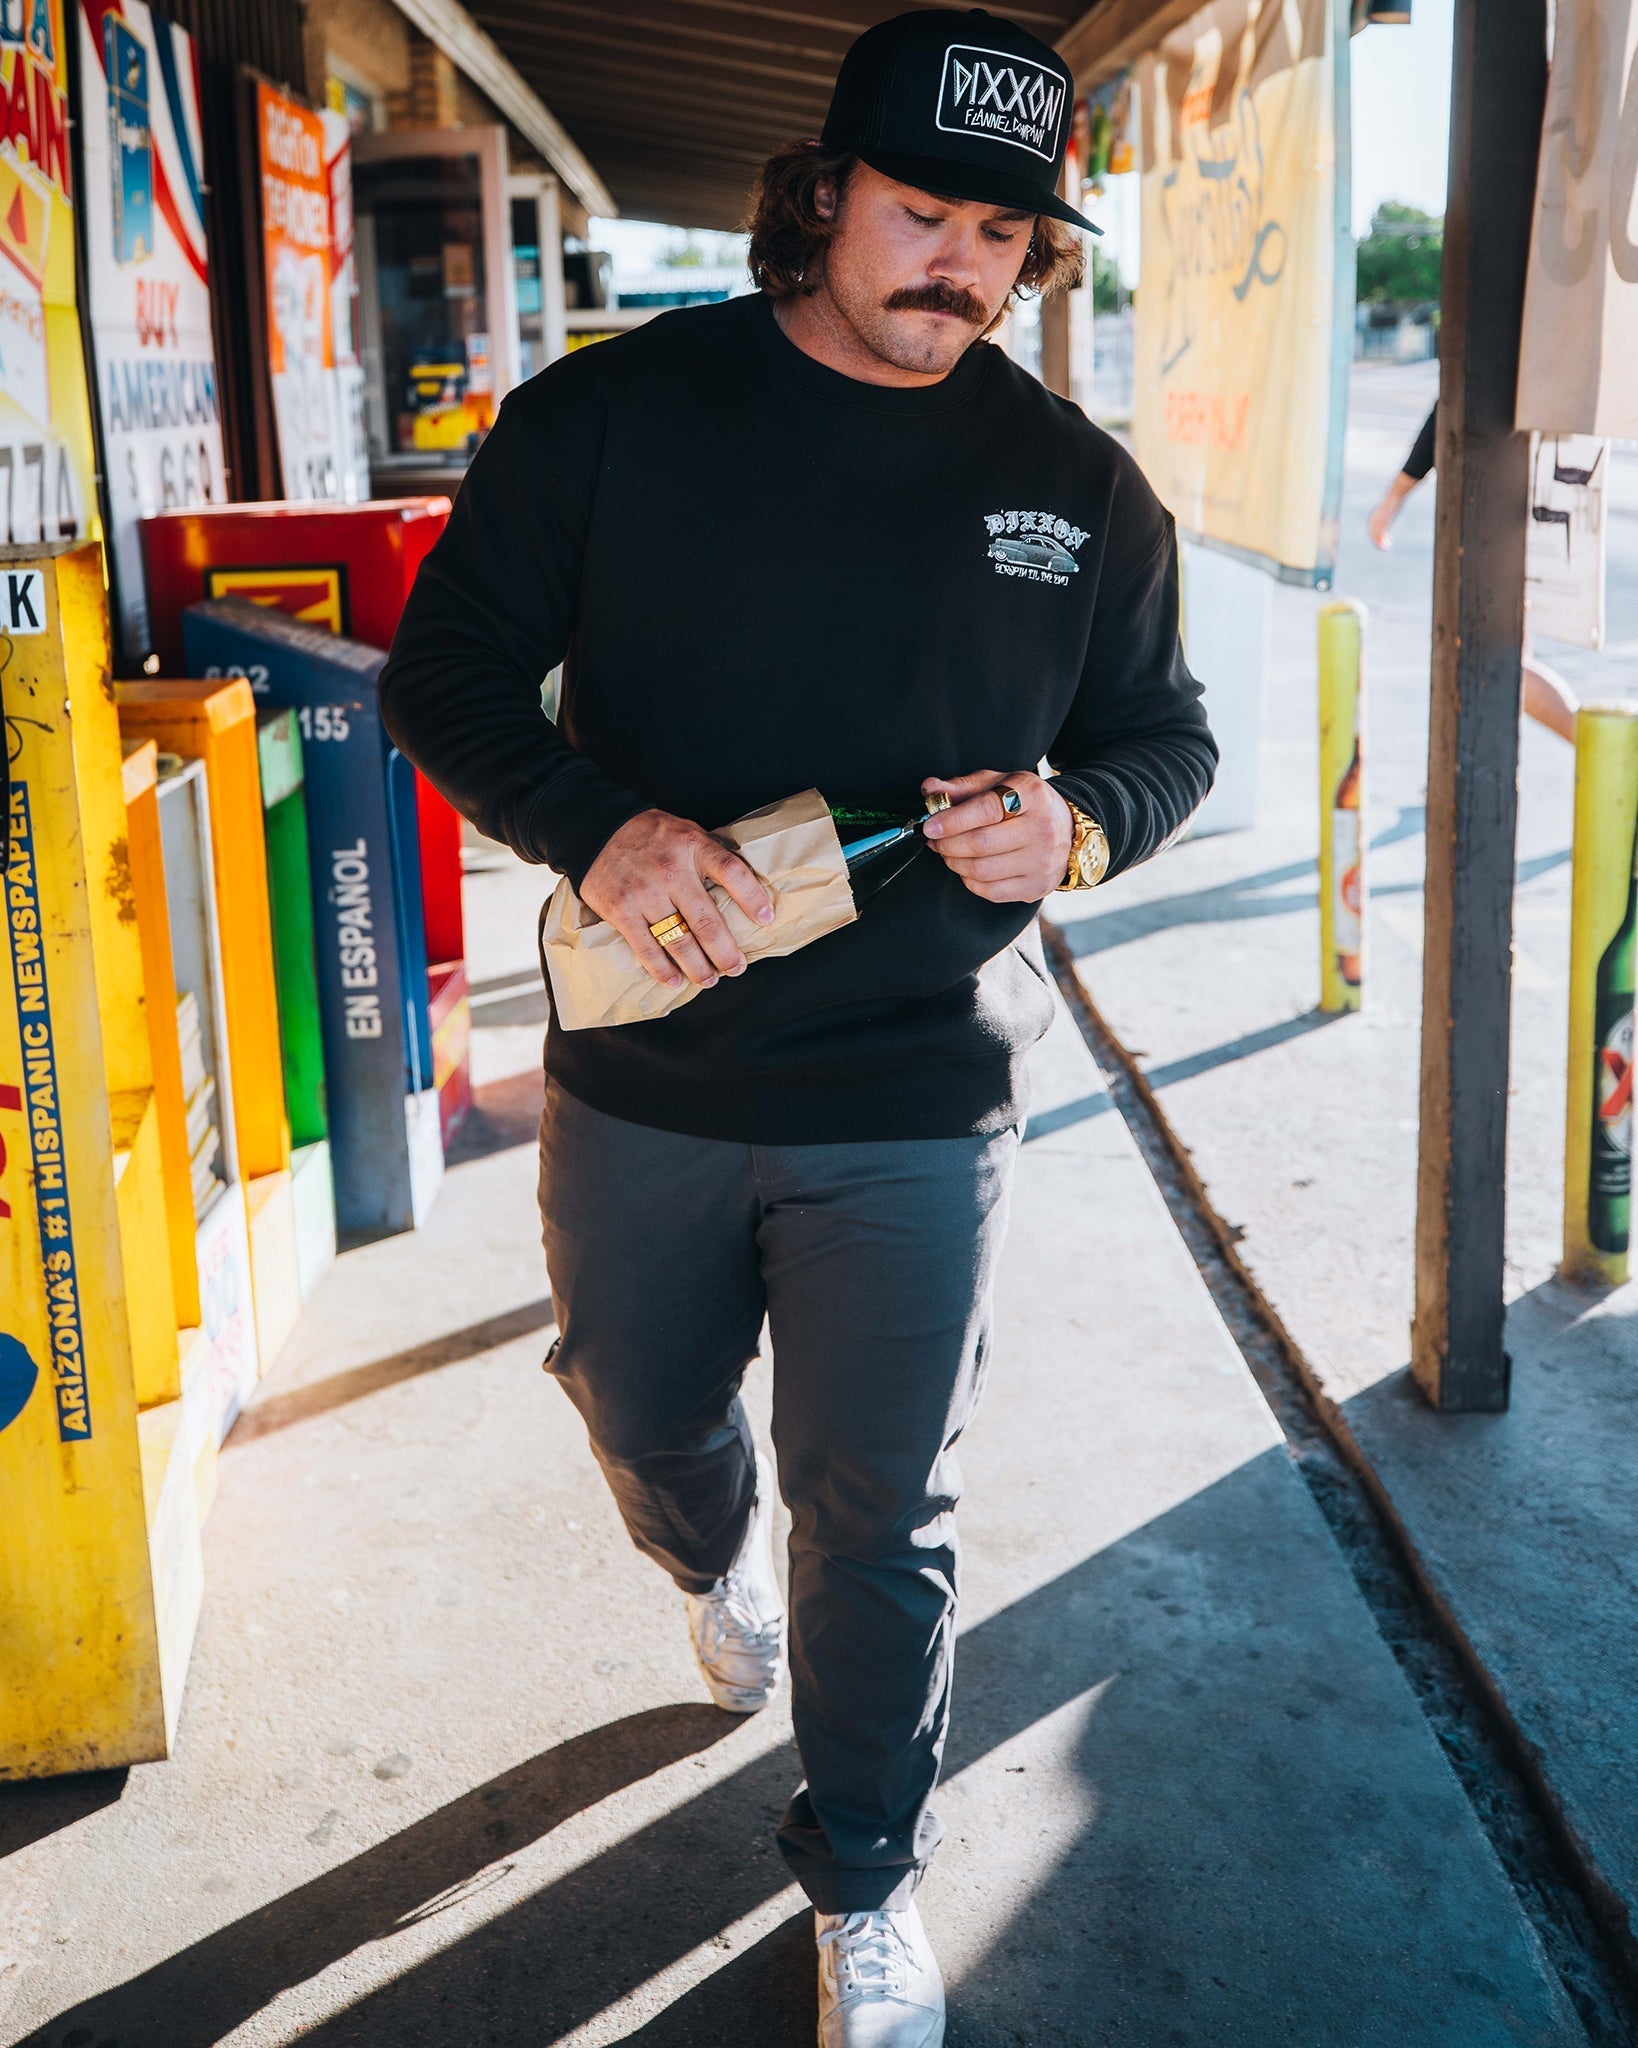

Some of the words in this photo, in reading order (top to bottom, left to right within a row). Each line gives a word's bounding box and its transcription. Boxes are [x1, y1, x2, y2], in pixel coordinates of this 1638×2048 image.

[953, 59, 1061, 131] DIXXON
[965, 108, 1012, 133] FLANNEL
[135, 277, 180, 347] BUY
[109, 359, 219, 433] AMERICAN
[984, 511, 1091, 550] DIXXON
[8, 574, 39, 628] K
[300, 706, 349, 742] 155
[7, 789, 46, 1013] NEWSPAPER
[328, 838, 377, 988] ESPAÑOL
[345, 994, 382, 1039] EN
[23, 1022, 63, 1190] HISPANIC
[48, 1250, 87, 1433] ARIZONA'S
